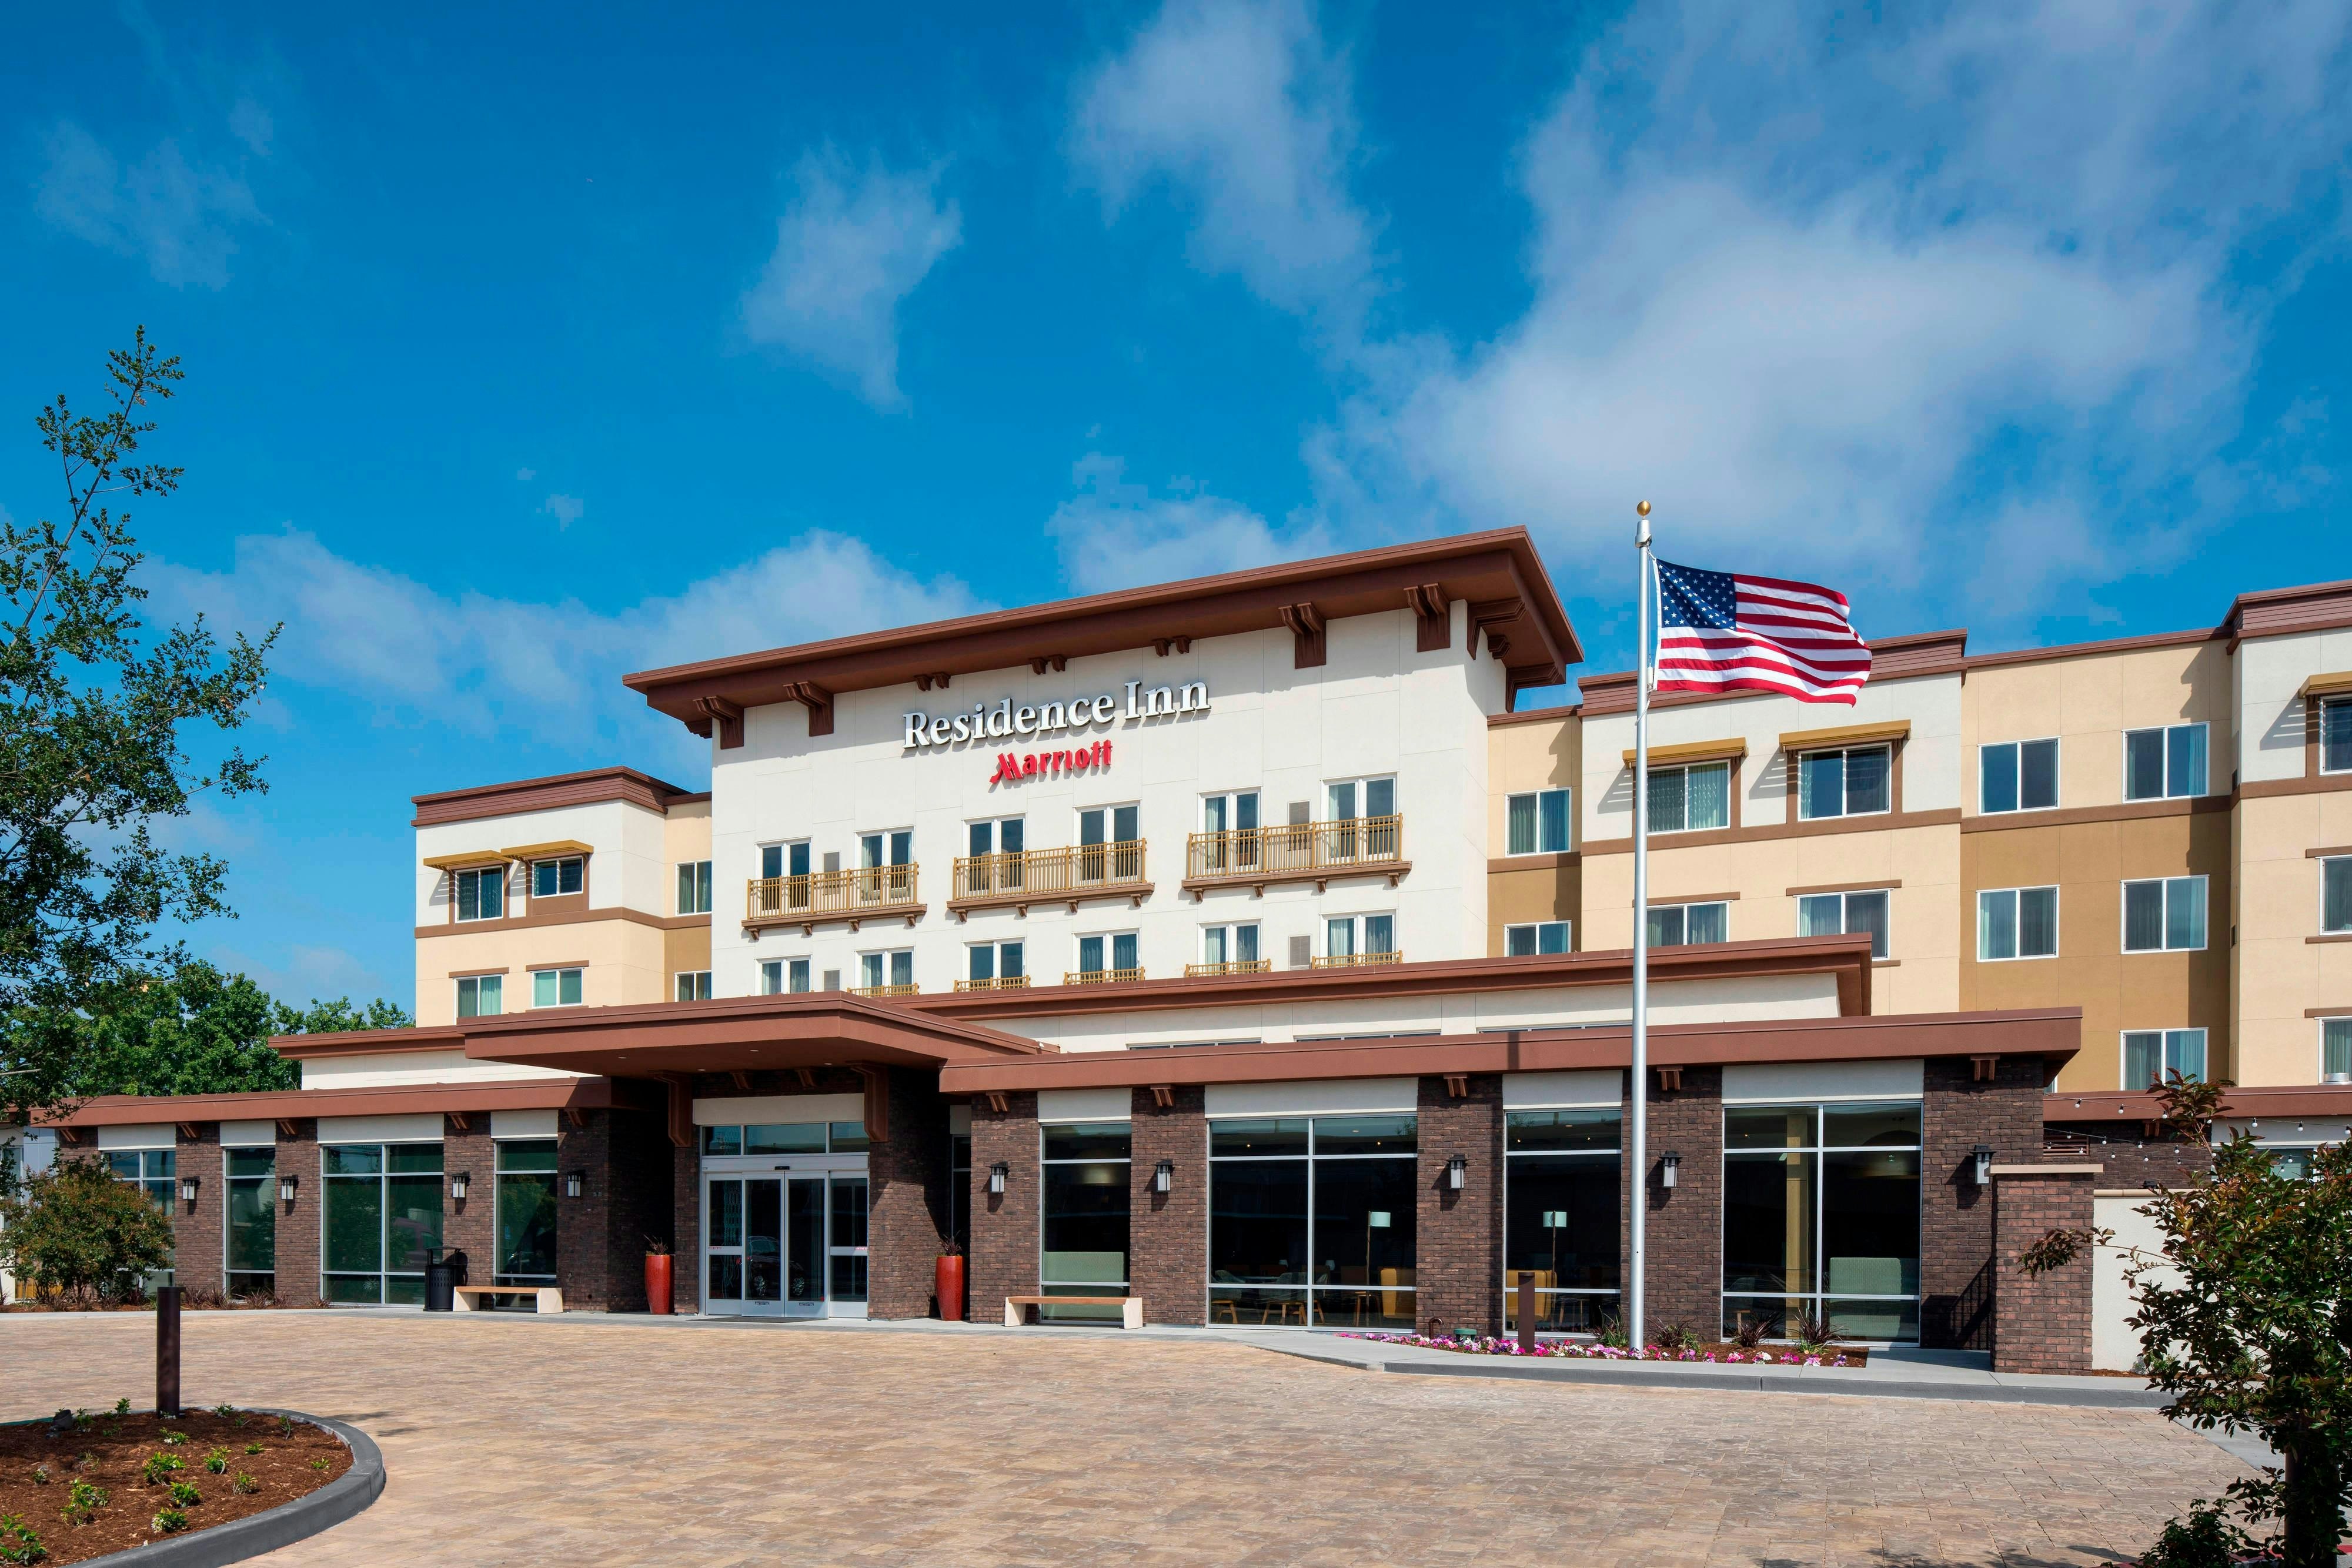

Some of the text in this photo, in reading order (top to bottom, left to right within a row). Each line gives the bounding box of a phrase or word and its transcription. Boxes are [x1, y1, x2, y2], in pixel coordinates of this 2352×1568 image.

[903, 680, 1211, 749] Residence Inn
[989, 739, 1112, 784] Marriott
